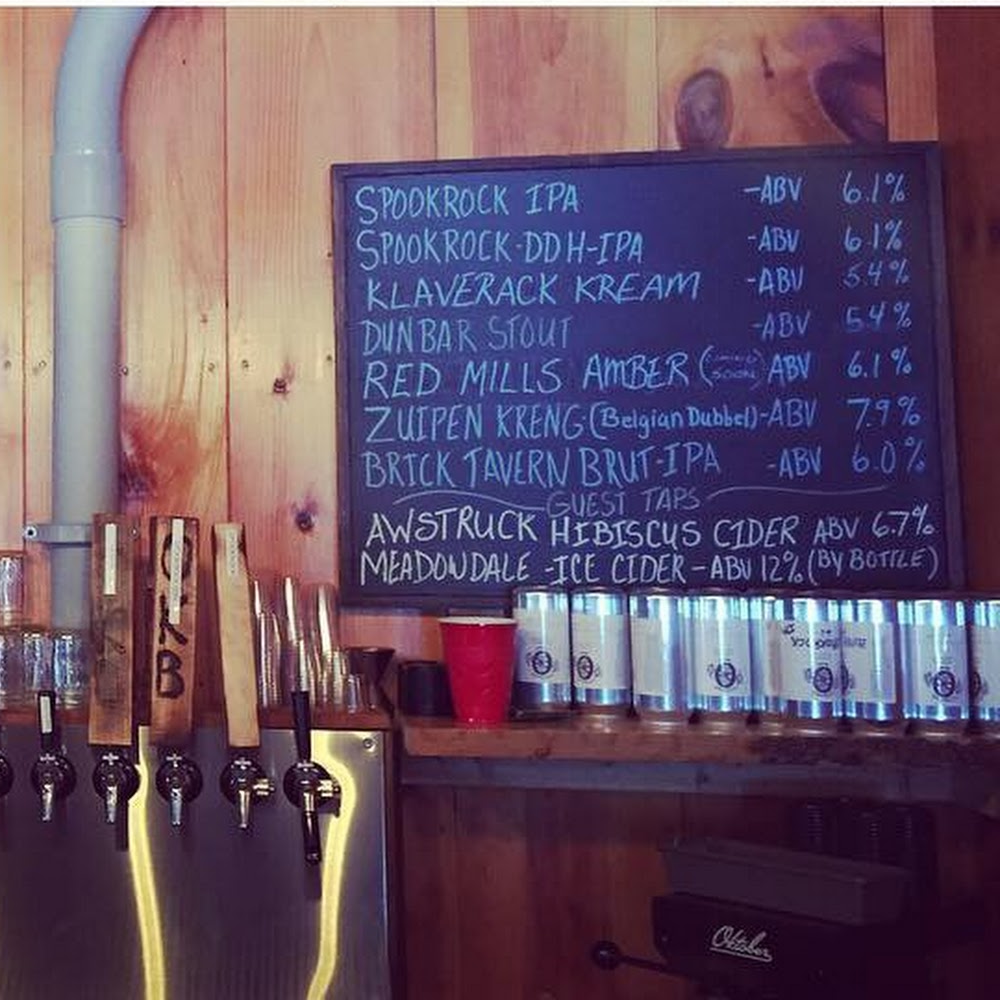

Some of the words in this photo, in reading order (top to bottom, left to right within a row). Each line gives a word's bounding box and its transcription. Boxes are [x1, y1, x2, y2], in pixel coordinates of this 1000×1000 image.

[355, 183, 509, 225] SPOOKROCK
[525, 181, 580, 215] IPA
[843, 171, 905, 204] 6.1%
[367, 271, 558, 312] KLAVERACK
[575, 270, 701, 304] KREAM
[362, 317, 478, 356] DUNBAR
[488, 314, 574, 351] STOUT
[363, 360, 442, 399] RED
[459, 358, 564, 397] MILLS
[583, 352, 690, 391] AMBER
[847, 347, 912, 379] 6.1%
[365, 404, 483, 443] ZUIPEN
[848, 396, 920, 432] 7.9%
[362, 451, 457, 489] BRICK
[463, 447, 570, 489] TAVERN
[852, 437, 925, 474] 6.0%
[546, 490, 625, 518] GUEST
[641, 486, 701, 512] TAPS
[365, 505, 538, 548] AWSTRUCK
[551, 516, 702, 549] HIBISCUS
[714, 515, 799, 548] CIDER
[813, 516, 860, 545] ABV
[872, 503, 936, 538] 6.7%
[360, 550, 531, 586] MEADOWDALE
[611, 553, 687, 585] CIDER
[761, 550, 804, 583] 12%
[808, 549, 842, 586] (BY
